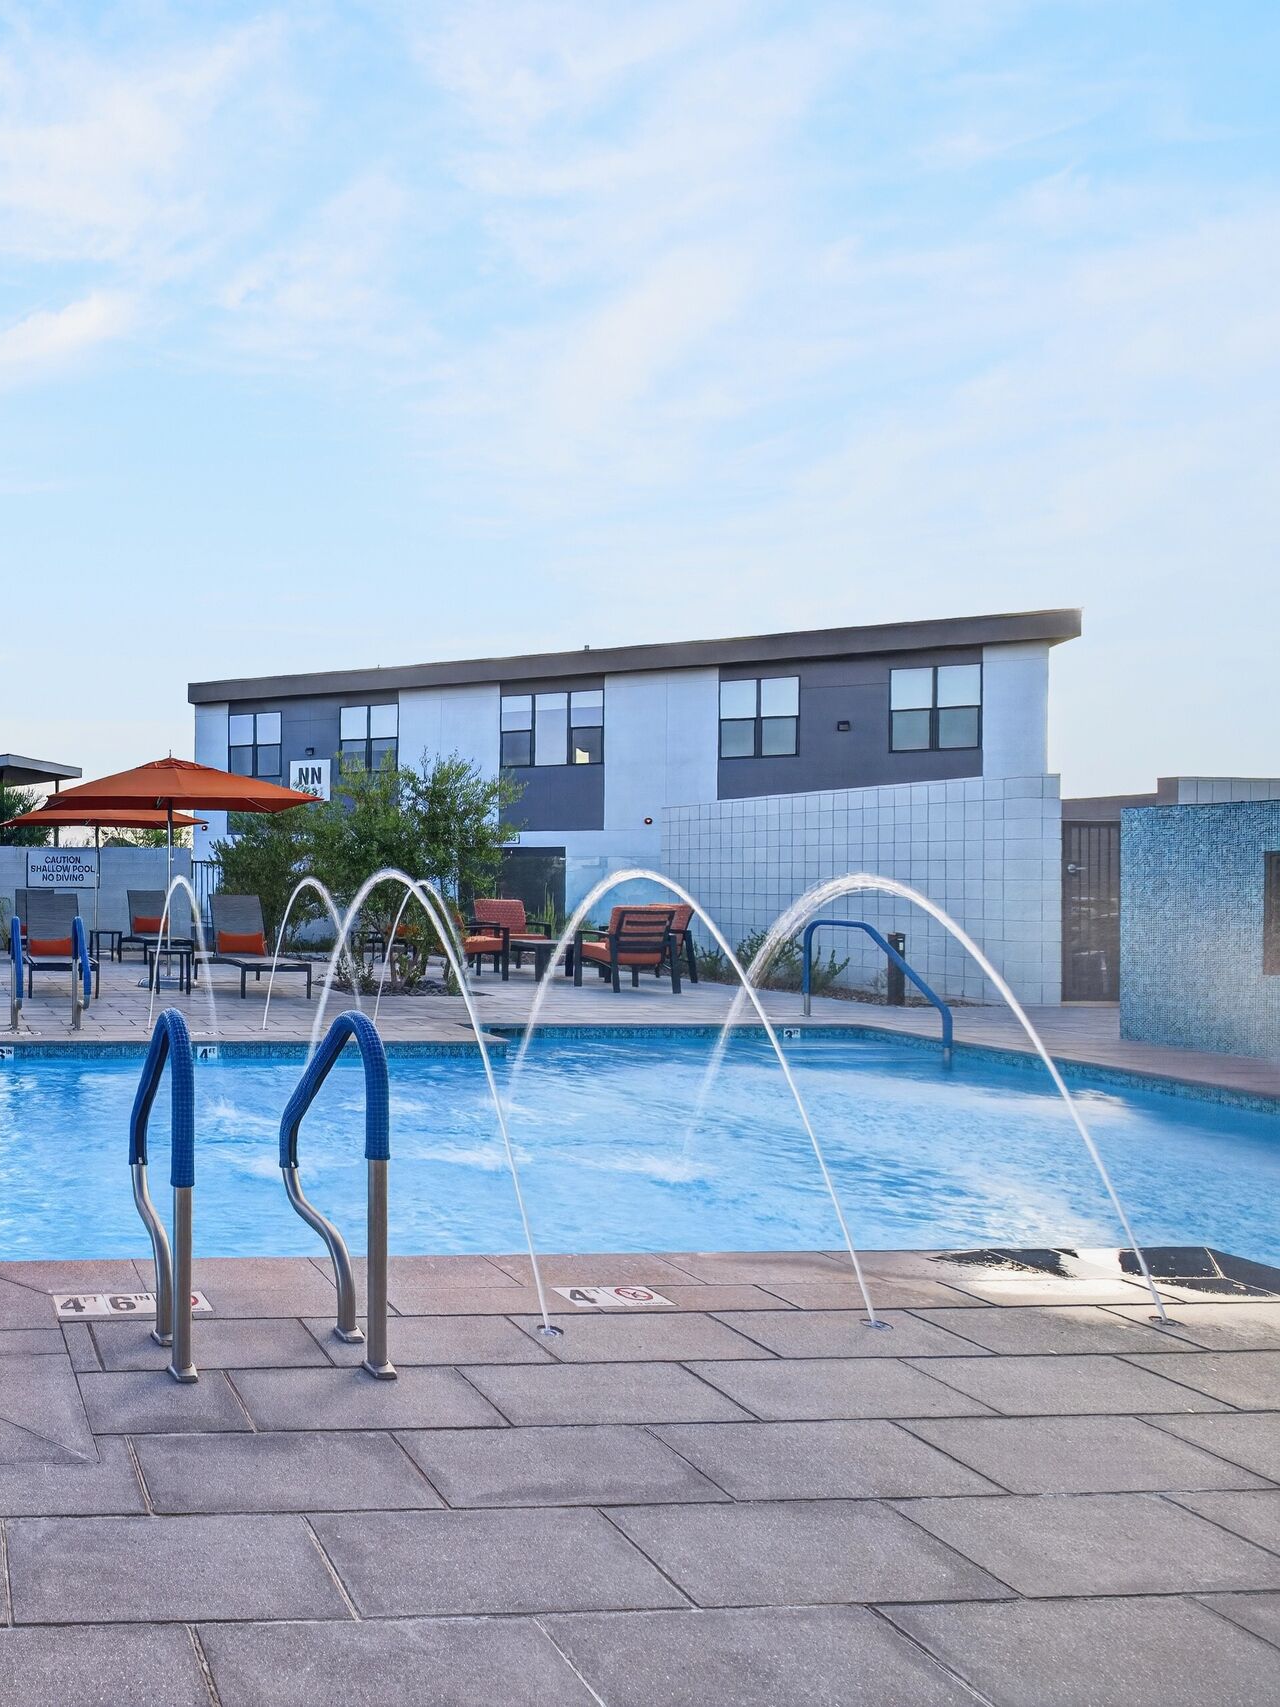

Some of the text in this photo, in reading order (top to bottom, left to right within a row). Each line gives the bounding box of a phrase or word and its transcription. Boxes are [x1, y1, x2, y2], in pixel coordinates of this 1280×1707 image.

[299, 766, 322, 785] NN
[44, 856, 81, 864] CAUTION
[30, 865, 95, 873] SHALLOW POOL
[42, 873, 84, 881] NO DIVING
[60, 1297, 86, 1312] 4
[109, 1296, 137, 1311] 6
